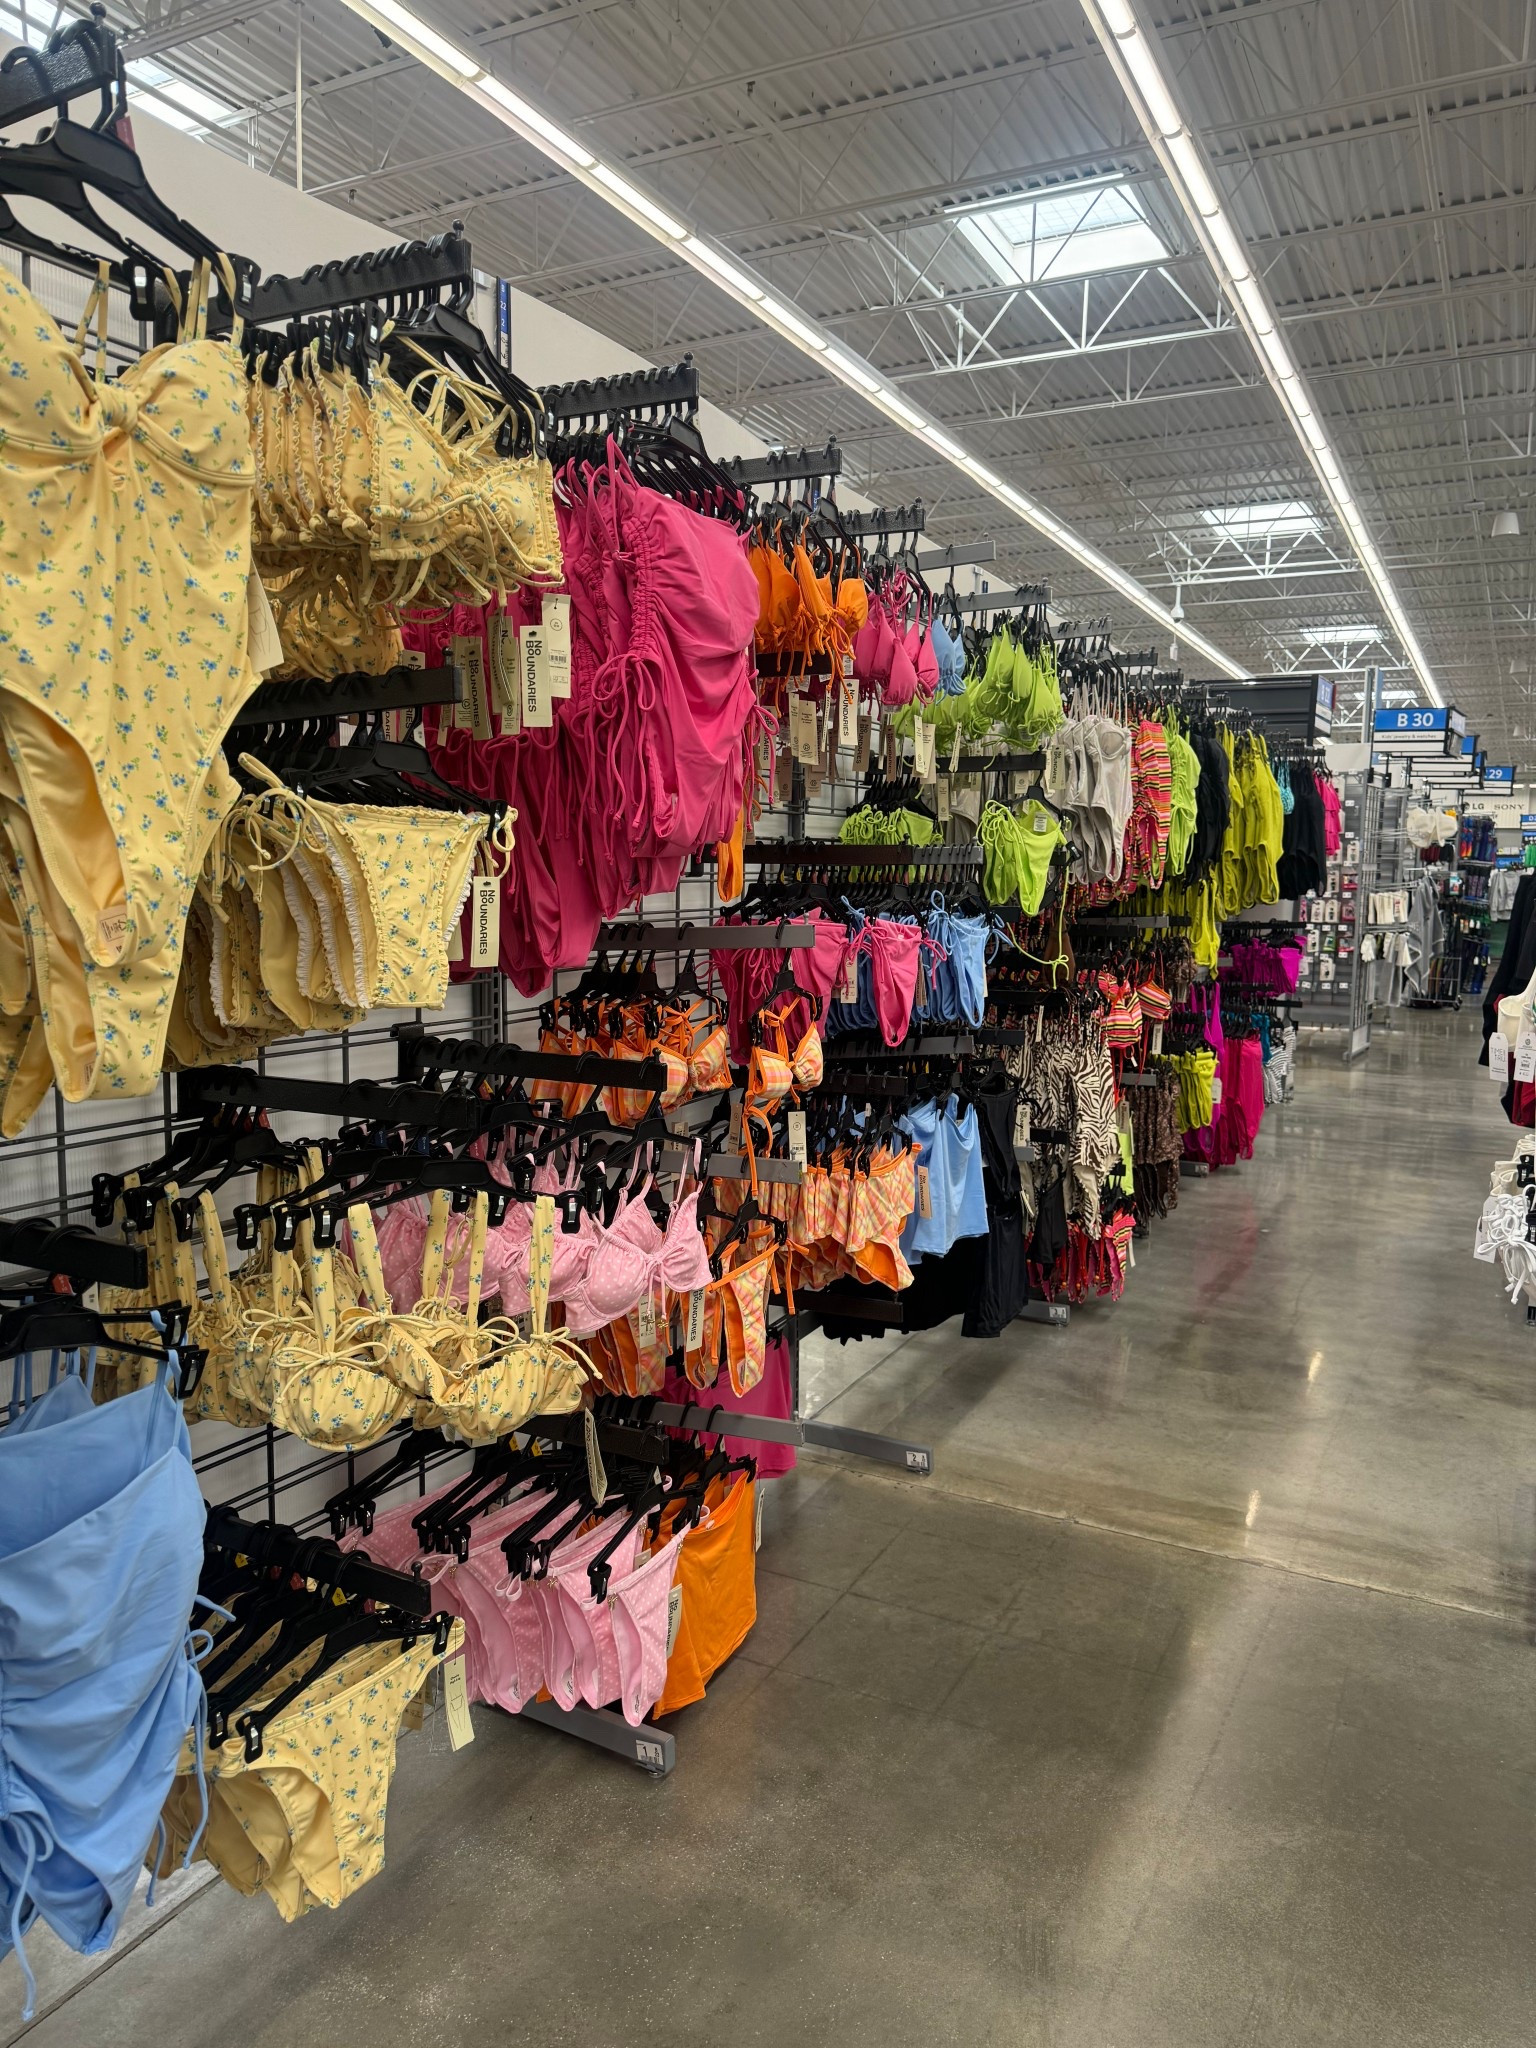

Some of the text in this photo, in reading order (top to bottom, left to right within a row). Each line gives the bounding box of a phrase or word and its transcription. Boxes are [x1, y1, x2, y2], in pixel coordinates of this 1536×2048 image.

[534, 640, 542, 656] NO
[472, 659, 479, 674] NO
[526, 640, 536, 712] BOUNDARIES
[468, 659, 480, 727] BOUNDARIES
[1397, 712, 1434, 727] B 30
[856, 724, 864, 764] BOUNDARIES
[1489, 769, 1503, 779] 29
[487, 889, 495, 904] NO
[479, 889, 488, 955] BOUNDARIES
[698, 1288, 704, 1300] NO
[690, 1290, 699, 1341] BOUNDARIES
[666, 1601, 674, 1651] BOUNDARIES
